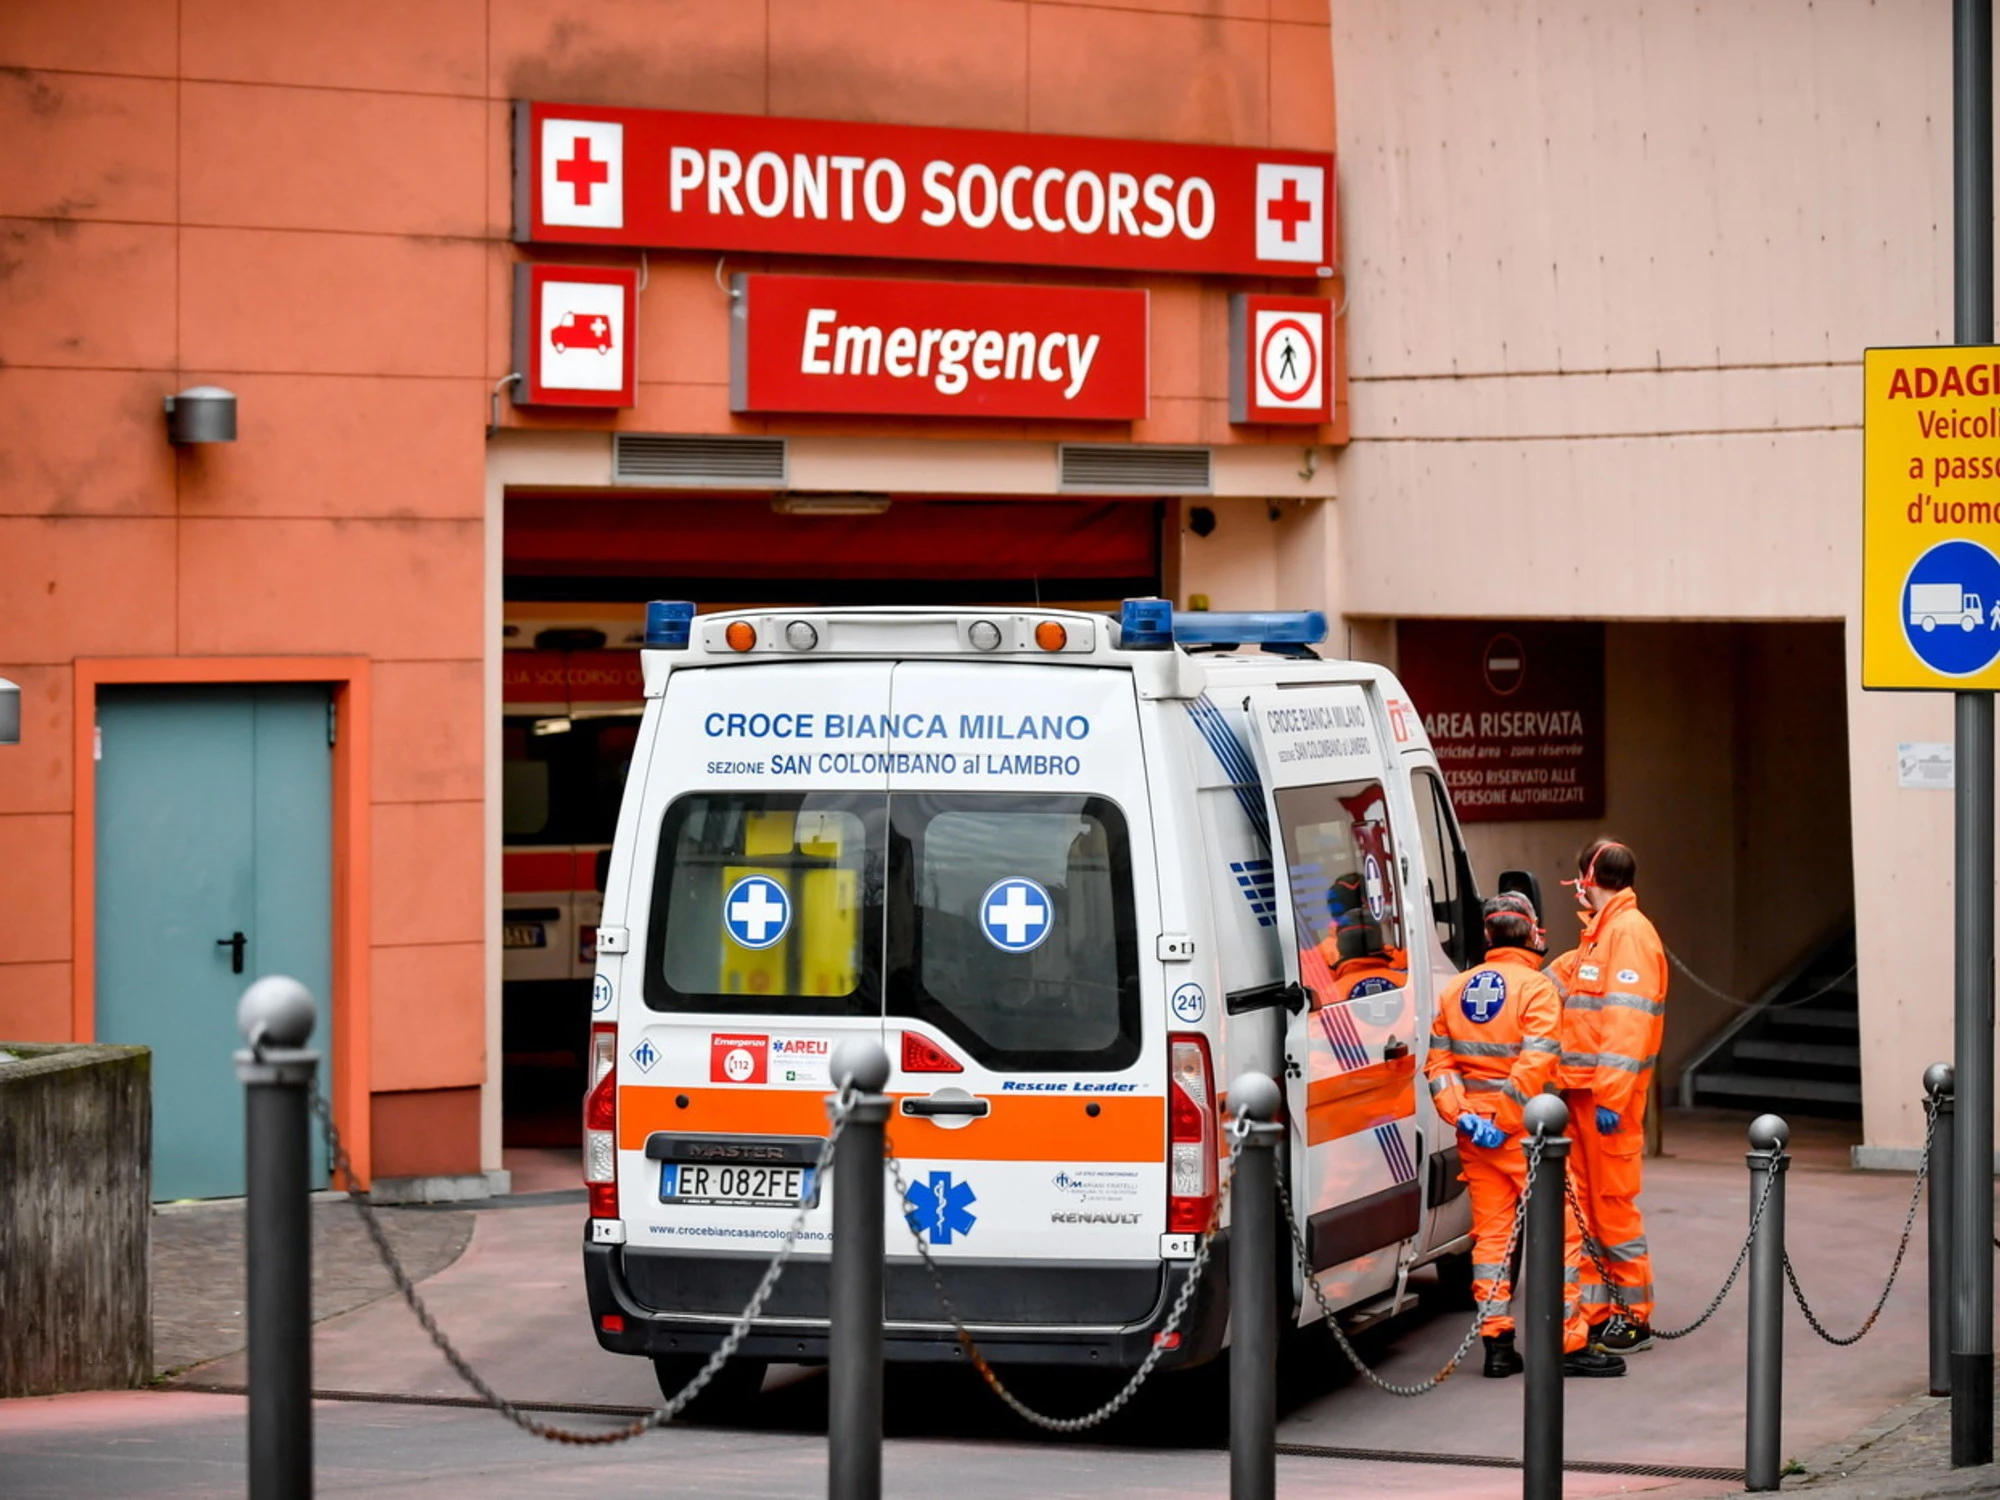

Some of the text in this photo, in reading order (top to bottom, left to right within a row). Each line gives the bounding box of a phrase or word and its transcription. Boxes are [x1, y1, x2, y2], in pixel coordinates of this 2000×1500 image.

[669, 146, 1217, 241] PRONTO SOCCORSO
[800, 308, 1100, 399] Emergency
[1887, 364, 2000, 400] ADAGI
[1917, 406, 2000, 439] Veicol
[1908, 457, 1924, 479] a
[704, 712, 1091, 740] CROCE BIANCA MILANO
[1267, 705, 1366, 734] CROCE BIANCA MILANO
[1425, 711, 1584, 739] AREA RISERVATA
[707, 753, 1081, 776] SEZIONE SAN COLOMBANO al LAMBRO
[1485, 768, 1549, 785] RISERVATO
[1551, 767, 1576, 783] ALLE
[1453, 786, 1584, 805] PERSONE AUTORIZZATE
[1177, 995, 1202, 1011] 241
[713, 1037, 766, 1048] Emergenza
[783, 1040, 828, 1055] AREU
[733, 1060, 749, 1070] 112
[1002, 1081, 1139, 1092] Rescue Leader
[689, 1144, 785, 1159] MASTER
[678, 1167, 710, 1196] ER
[719, 1168, 801, 1198] 082FE
[1051, 1212, 1143, 1225] RENAULT
